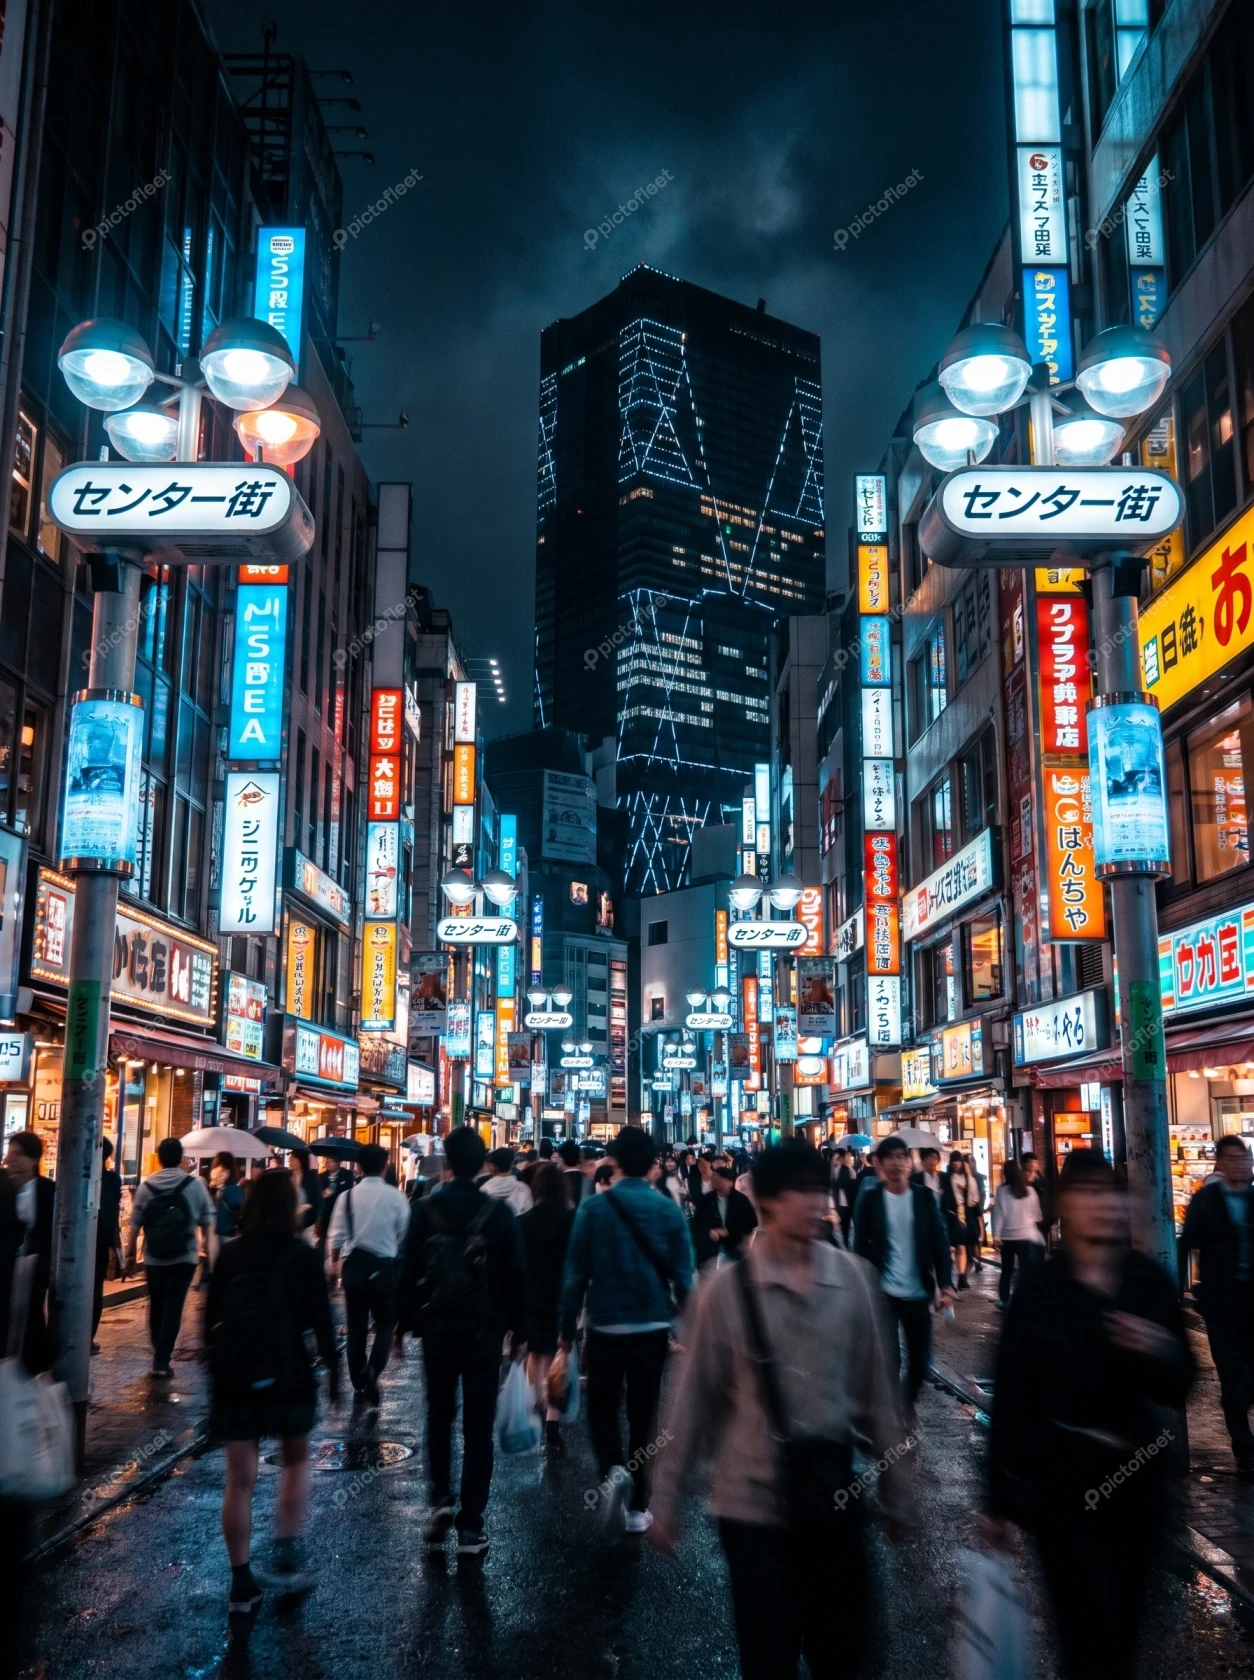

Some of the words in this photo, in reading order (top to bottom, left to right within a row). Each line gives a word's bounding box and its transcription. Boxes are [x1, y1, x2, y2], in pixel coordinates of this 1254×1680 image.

[72, 480, 277, 518] センター街
[962, 484, 1163, 522] センター街
[444, 924, 512, 937] センター街
[734, 928, 802, 941] センター街
